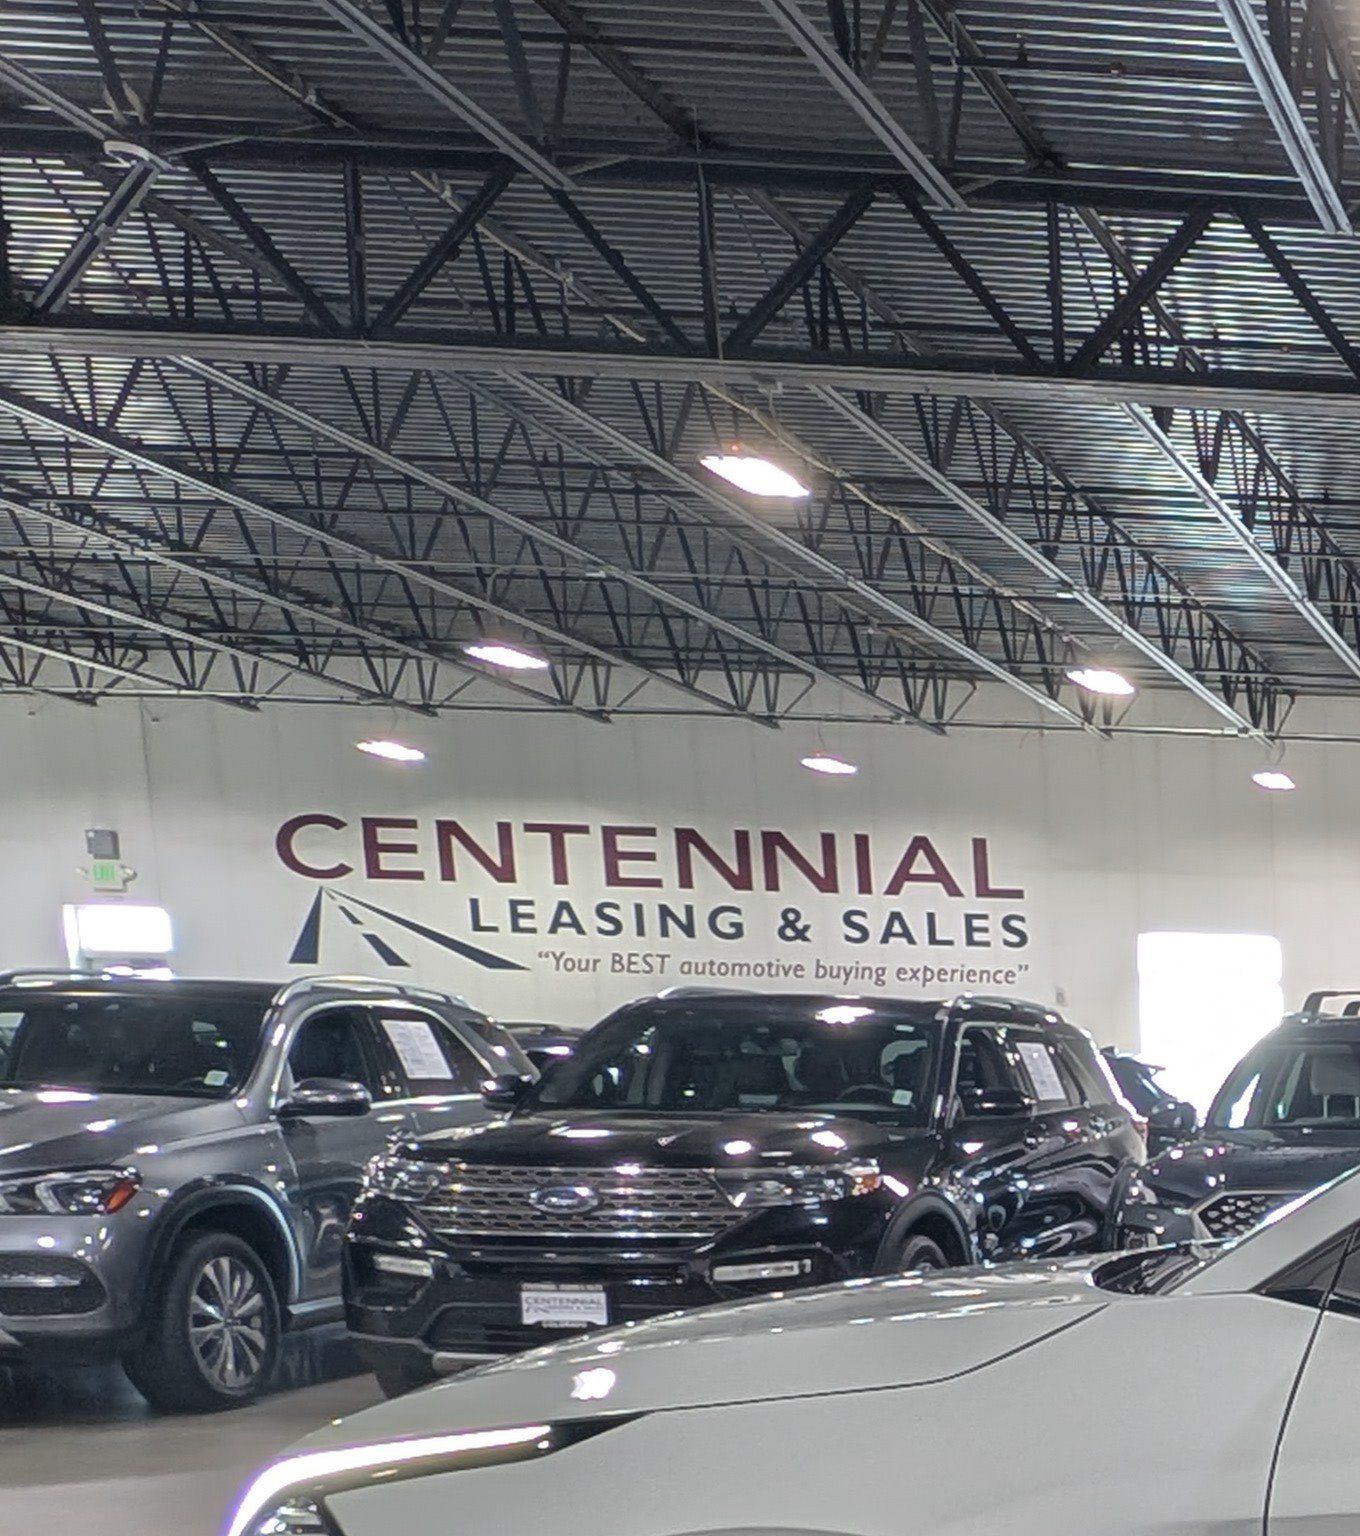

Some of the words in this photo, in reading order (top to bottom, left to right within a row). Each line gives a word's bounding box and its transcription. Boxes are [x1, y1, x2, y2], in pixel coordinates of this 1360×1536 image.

[275, 813, 1025, 901] CENTENNIAL
[468, 897, 746, 940] LEASING
[776, 907, 812, 943] &
[842, 909, 1029, 948] SALES
[610, 952, 671, 975] BEST
[679, 957, 806, 980] automotive
[814, 958, 887, 987] buying
